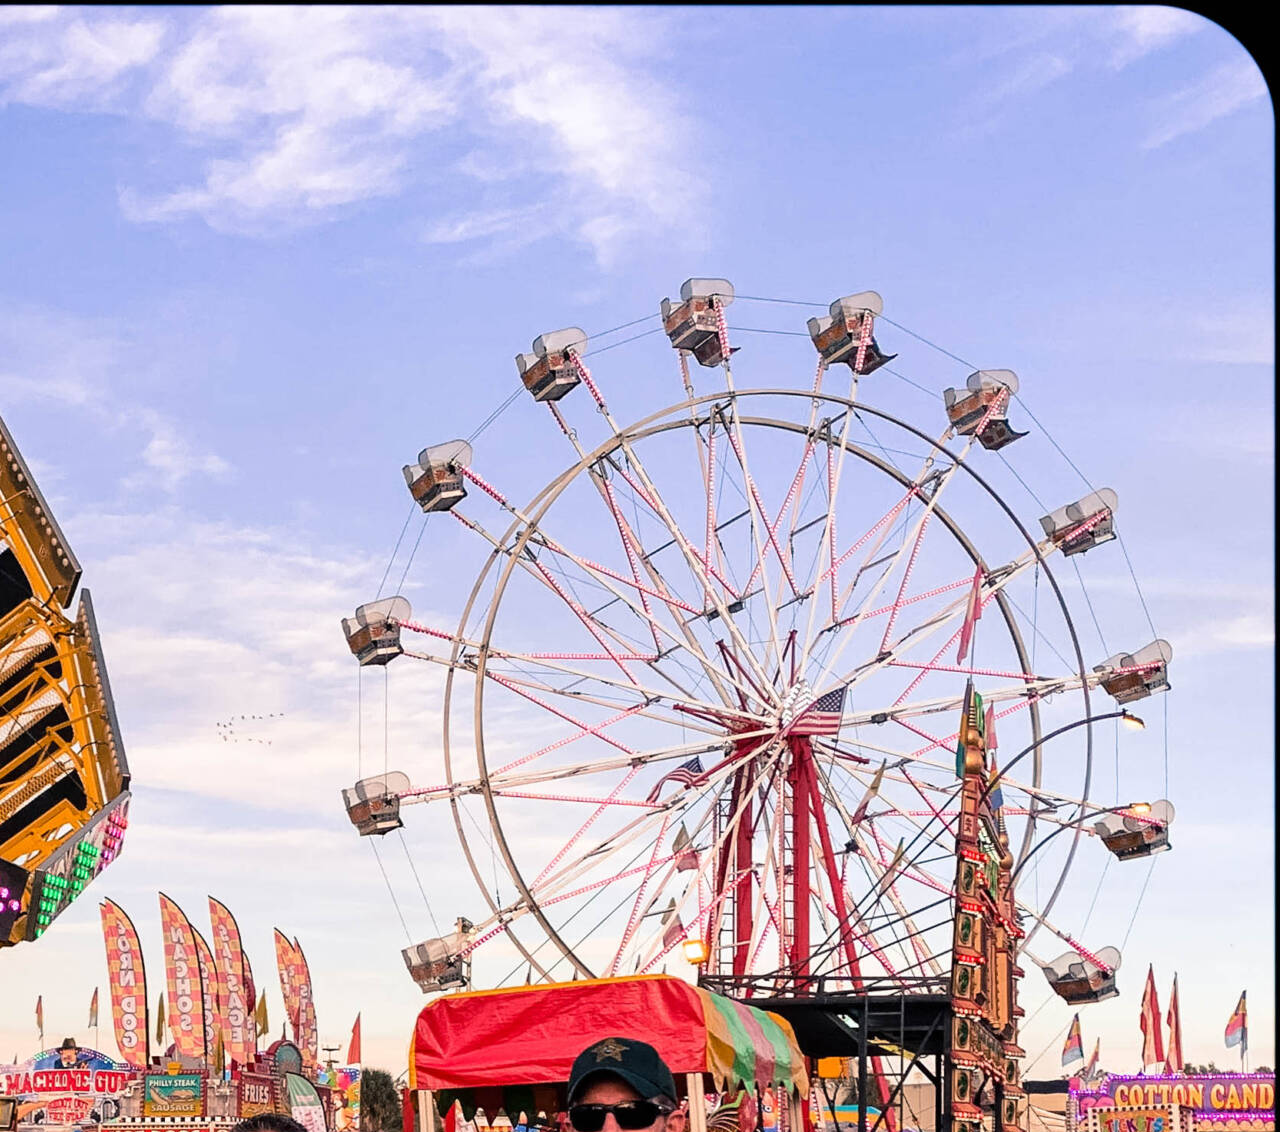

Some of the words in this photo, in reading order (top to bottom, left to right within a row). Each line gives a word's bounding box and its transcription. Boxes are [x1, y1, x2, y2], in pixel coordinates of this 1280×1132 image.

[5, 1070, 91, 1096] MACHINE
[244, 1083, 269, 1104] FRIES
[151, 1103, 195, 1112] SAUSAGE
[1114, 1084, 1204, 1109] COTTON
[1210, 1083, 1275, 1110] CAND
